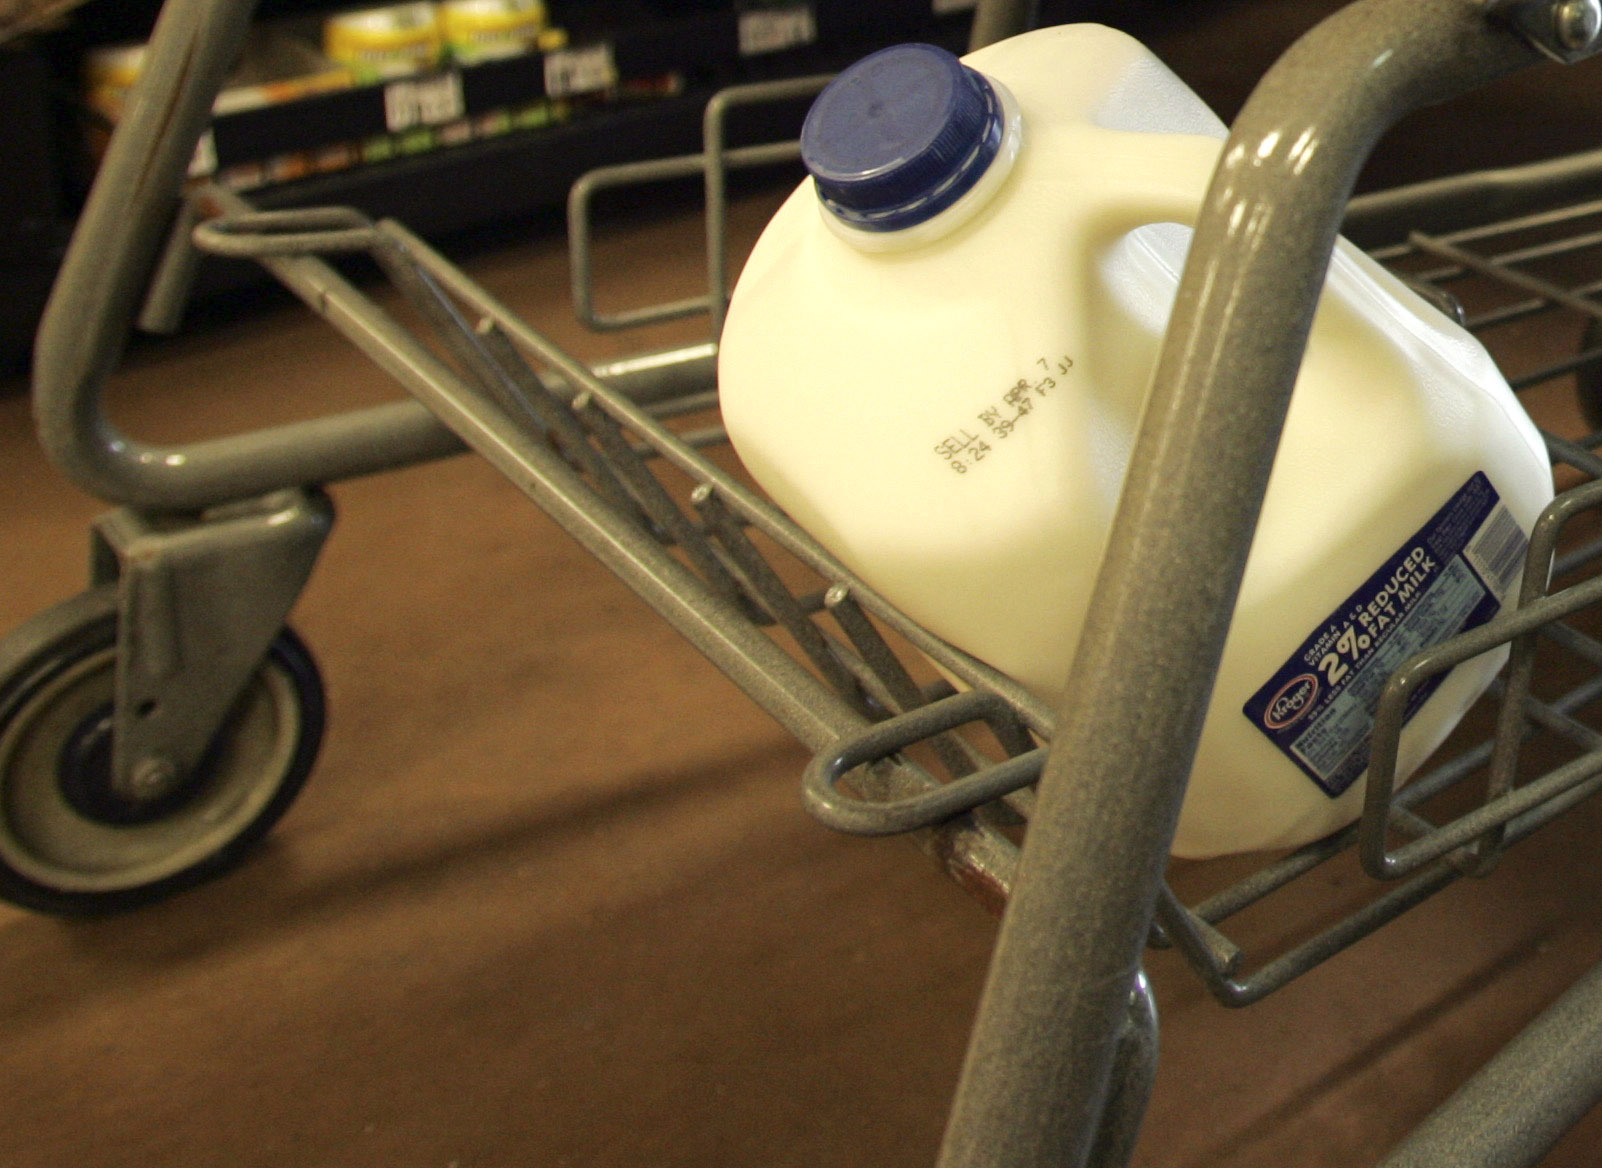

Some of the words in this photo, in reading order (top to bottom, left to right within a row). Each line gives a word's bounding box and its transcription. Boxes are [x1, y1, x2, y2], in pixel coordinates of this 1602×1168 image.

[934, 429, 979, 460] SELL
[978, 405, 1002, 428] BY
[1036, 357, 1049, 371] 7
[1358, 546, 1425, 627] REDUCED
[1368, 601, 1396, 639] FAT
[1397, 556, 1436, 605] MILK
[1304, 632, 1330, 663] GRADE
[1308, 631, 1341, 667] VITAMIN
[1318, 625, 1371, 687] 2%
[1340, 670, 1355, 687] FAT
[1355, 647, 1375, 671] THAN
[1271, 681, 1312, 721] Kroger
